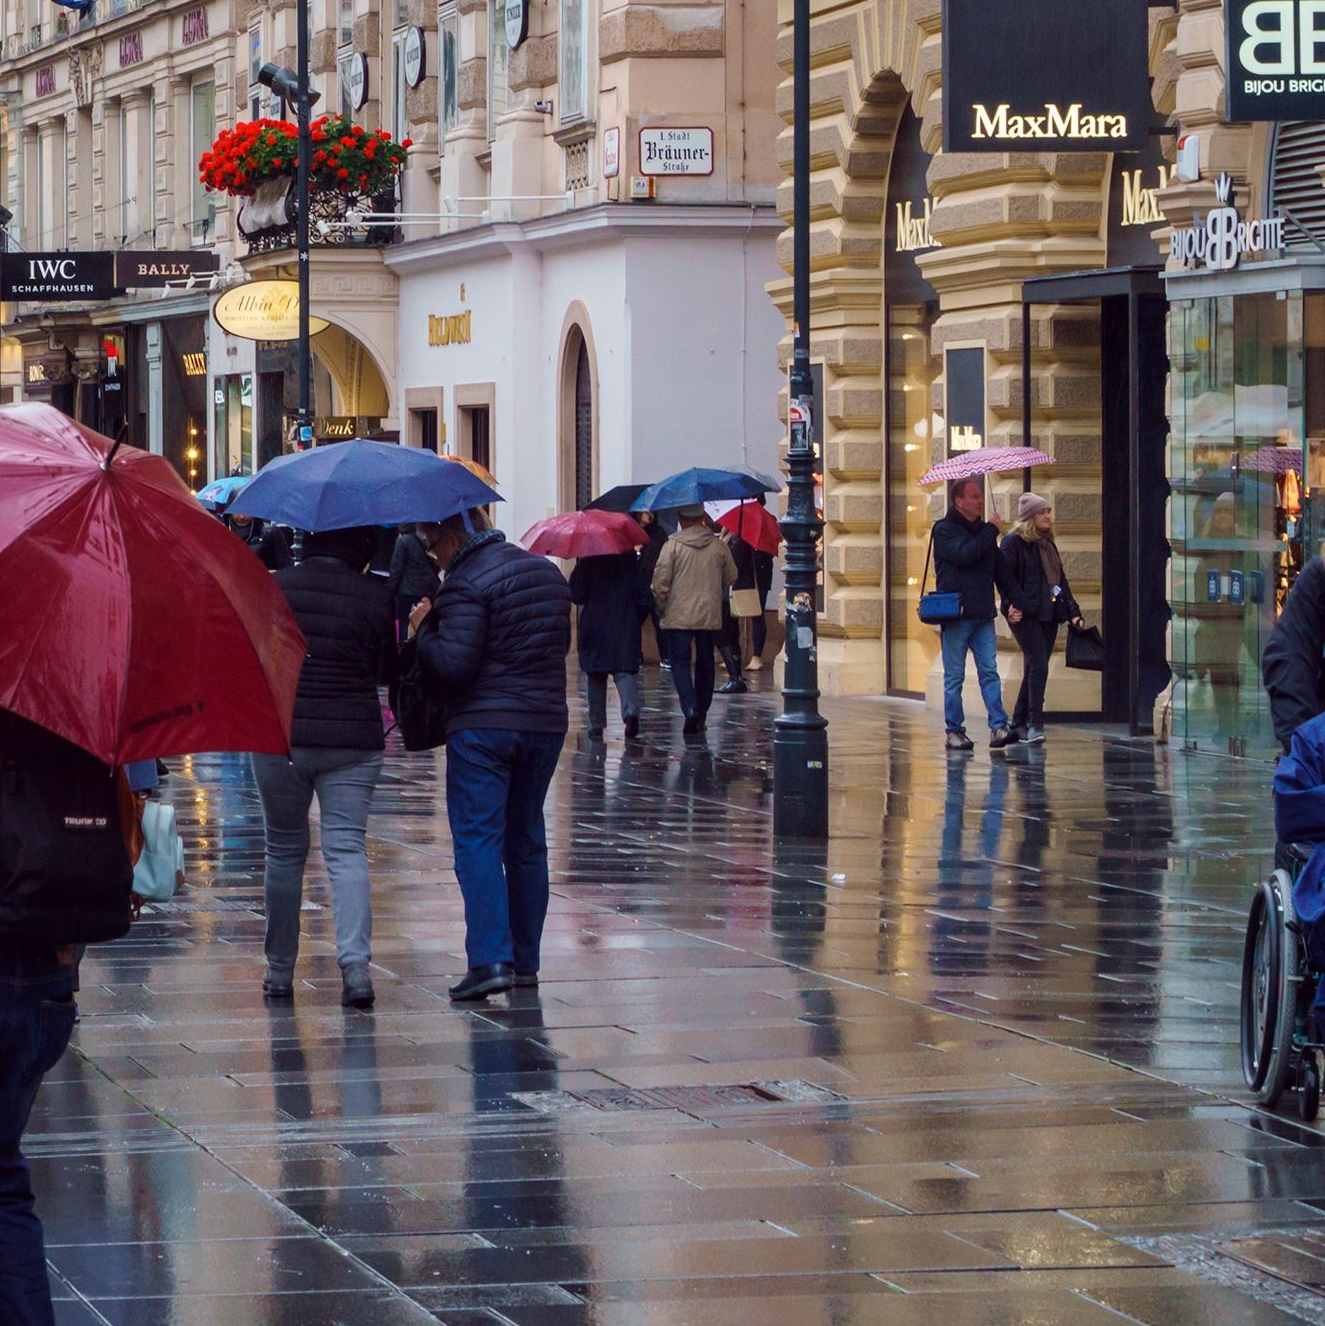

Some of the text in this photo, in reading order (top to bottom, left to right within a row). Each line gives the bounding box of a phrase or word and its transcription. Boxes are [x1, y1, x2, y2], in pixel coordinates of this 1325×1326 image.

[1244, 80, 1285, 96] BIJOU
[971, 104, 1127, 138] MaxMara
[668, 131, 690, 141] Stadt
[645, 142, 709, 162] Bräuner-
[1121, 165, 1177, 226] MaxM
[896, 197, 942, 252] MaxM
[1171, 227, 1206, 266] BIJOU
[29, 260, 76, 279] IWC
[138, 264, 189, 275] BALLY
[11, 285, 94, 293] SCHAFFHAUSEN
[183, 353, 206, 375] BALLY
